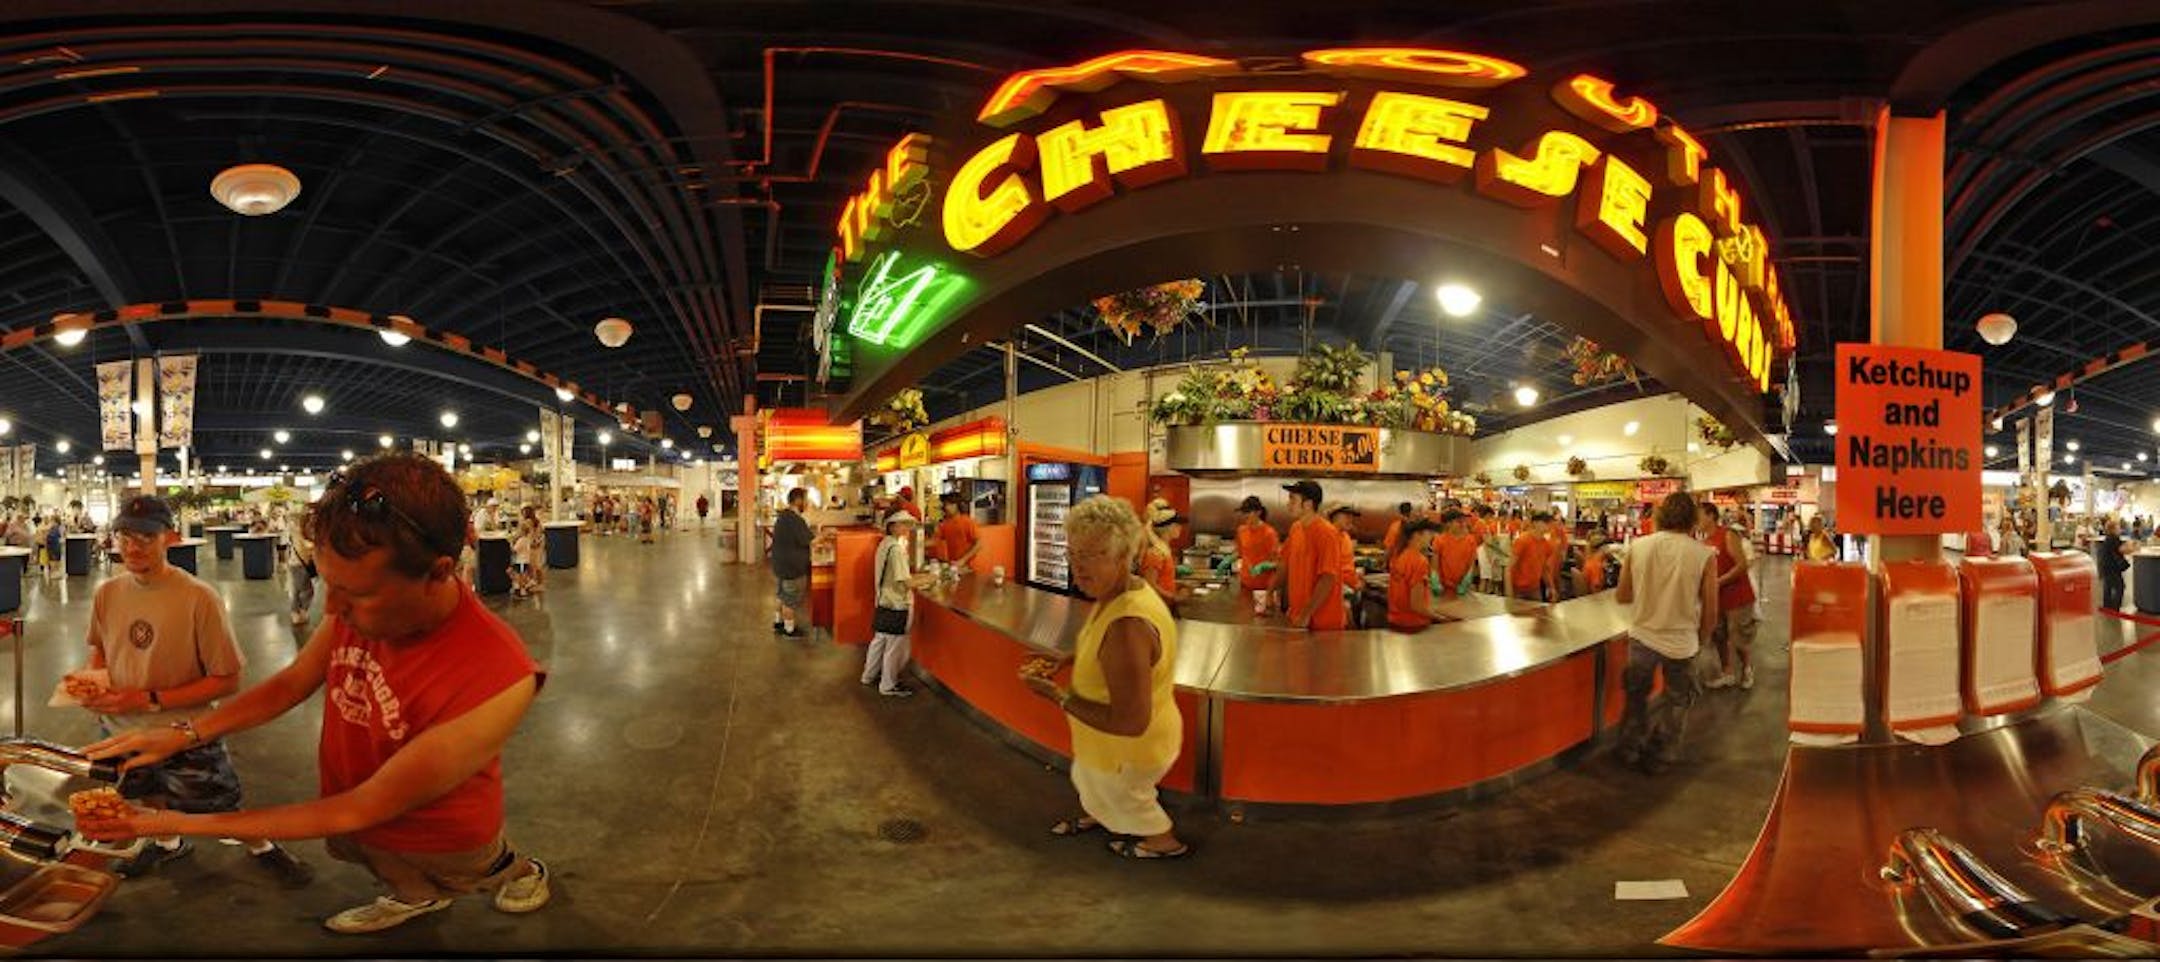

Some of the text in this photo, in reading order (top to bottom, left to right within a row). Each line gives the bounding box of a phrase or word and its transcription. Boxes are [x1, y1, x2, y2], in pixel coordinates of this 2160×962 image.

[837, 132, 932, 260] THE
[942, 91, 1773, 394] CHEESE CURDS
[1850, 356, 1970, 397] Ketchup
[1885, 399, 1940, 427] and
[1267, 428, 1340, 446] CHEESE
[1273, 448, 1335, 466] CURDS
[1850, 436, 1970, 474] Napkins
[1876, 486, 1946, 519] Here
